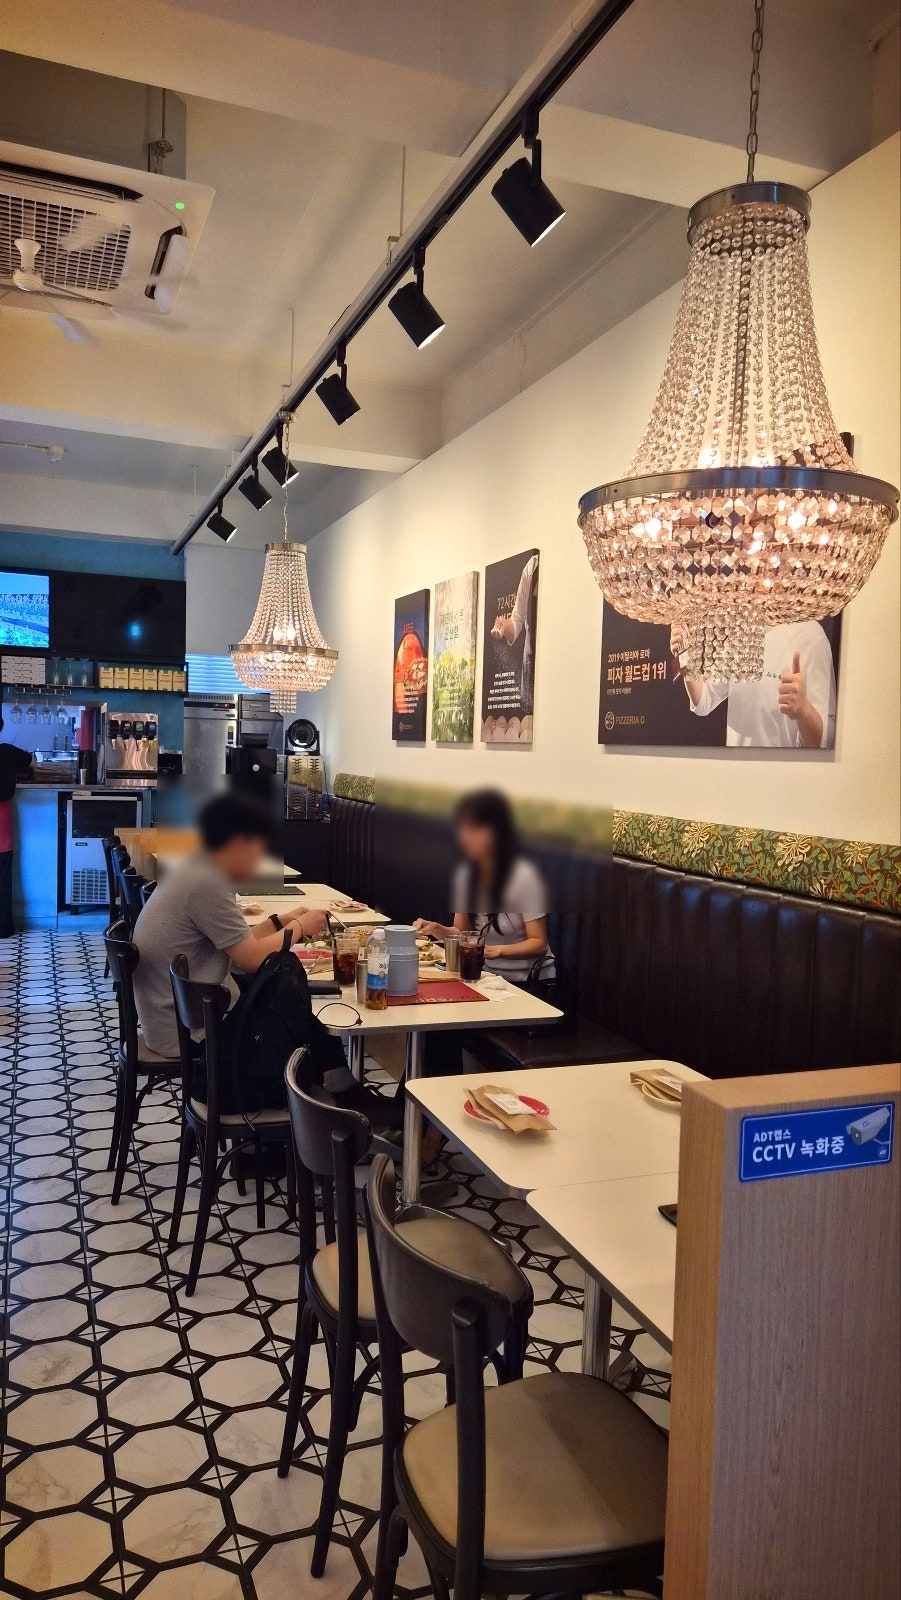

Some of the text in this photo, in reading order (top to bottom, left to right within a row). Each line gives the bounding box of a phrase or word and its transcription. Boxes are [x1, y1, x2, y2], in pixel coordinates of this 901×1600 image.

[608, 653, 620, 663] 2019
[640, 648, 651, 659] 로마
[607, 660, 667, 685] 피자 월드컵 1위
[615, 715, 639, 725] PIZZERIA
[753, 1128, 792, 1143] ADT캡스
[752, 1135, 845, 1163] CCTV 녹화중
